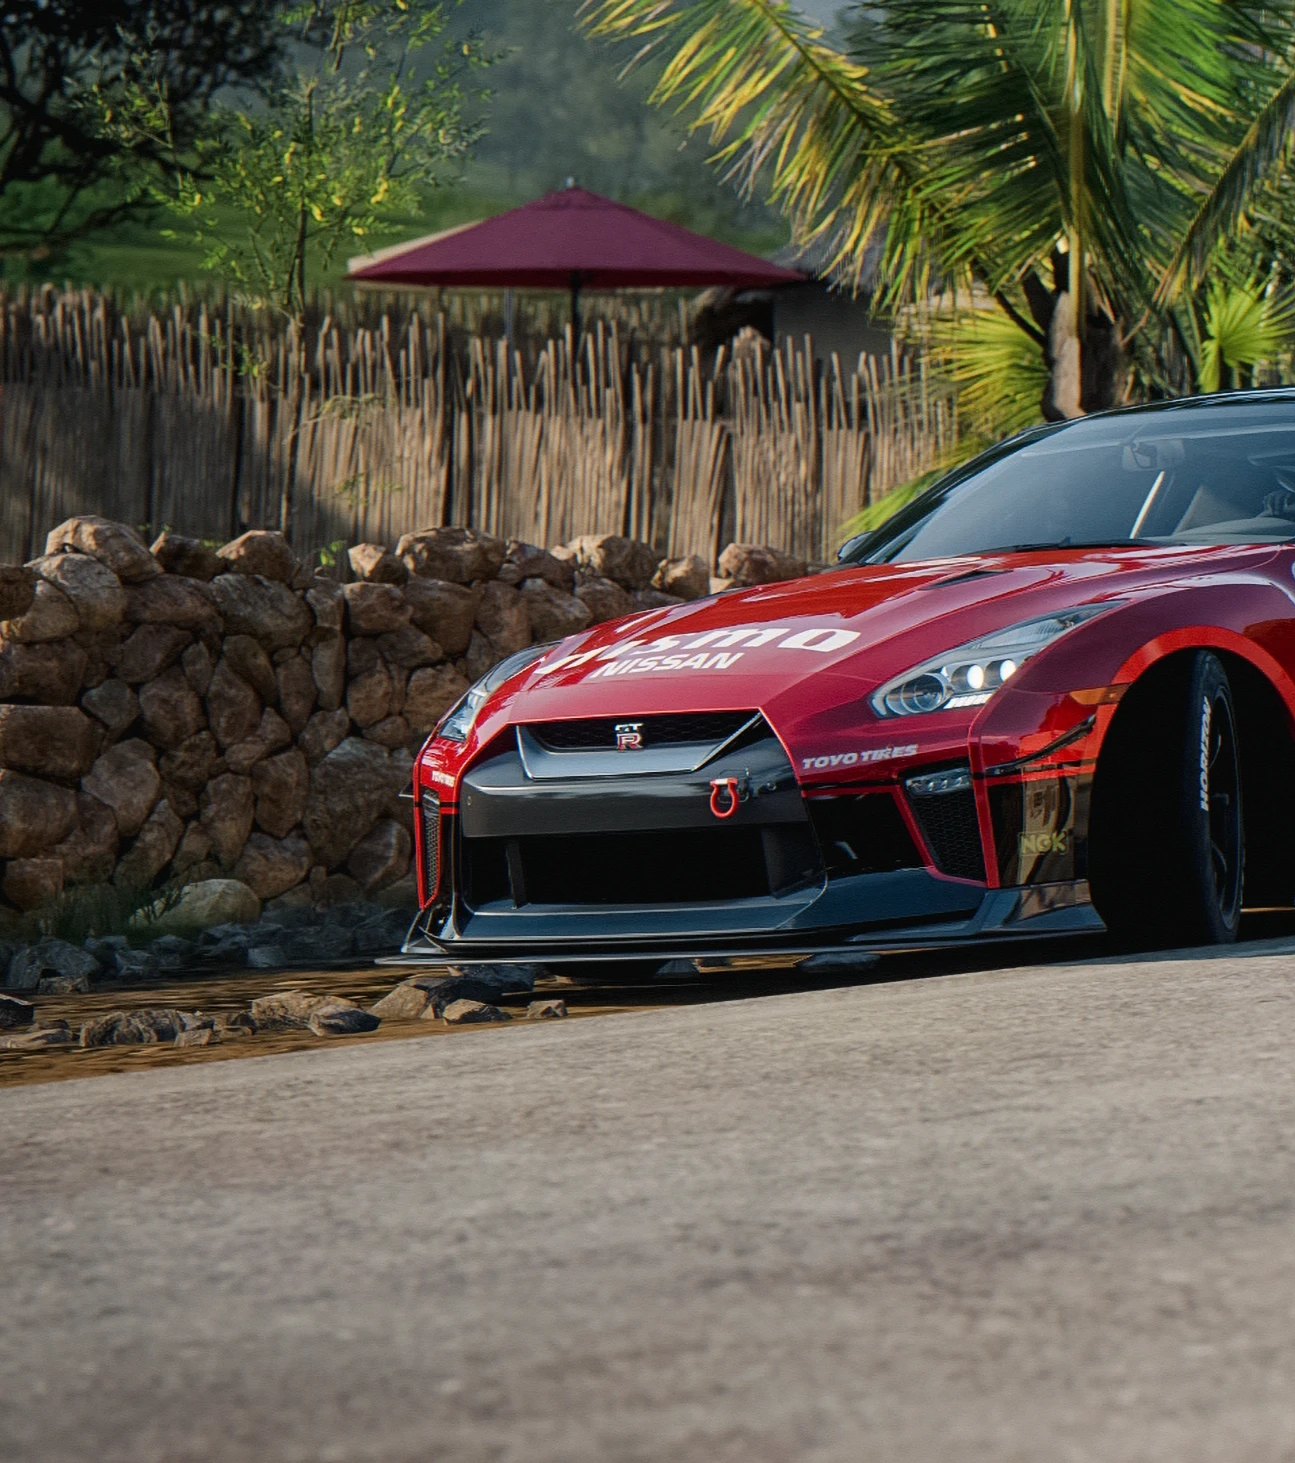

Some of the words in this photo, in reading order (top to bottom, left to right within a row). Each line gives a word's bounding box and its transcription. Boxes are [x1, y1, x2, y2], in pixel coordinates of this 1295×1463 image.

[534, 628, 861, 676] nismo
[590, 652, 745, 679] NISSAN
[802, 752, 858, 769] TOYO
[860, 744, 918, 761] TIRES
[1021, 832, 1067, 853] NGK
